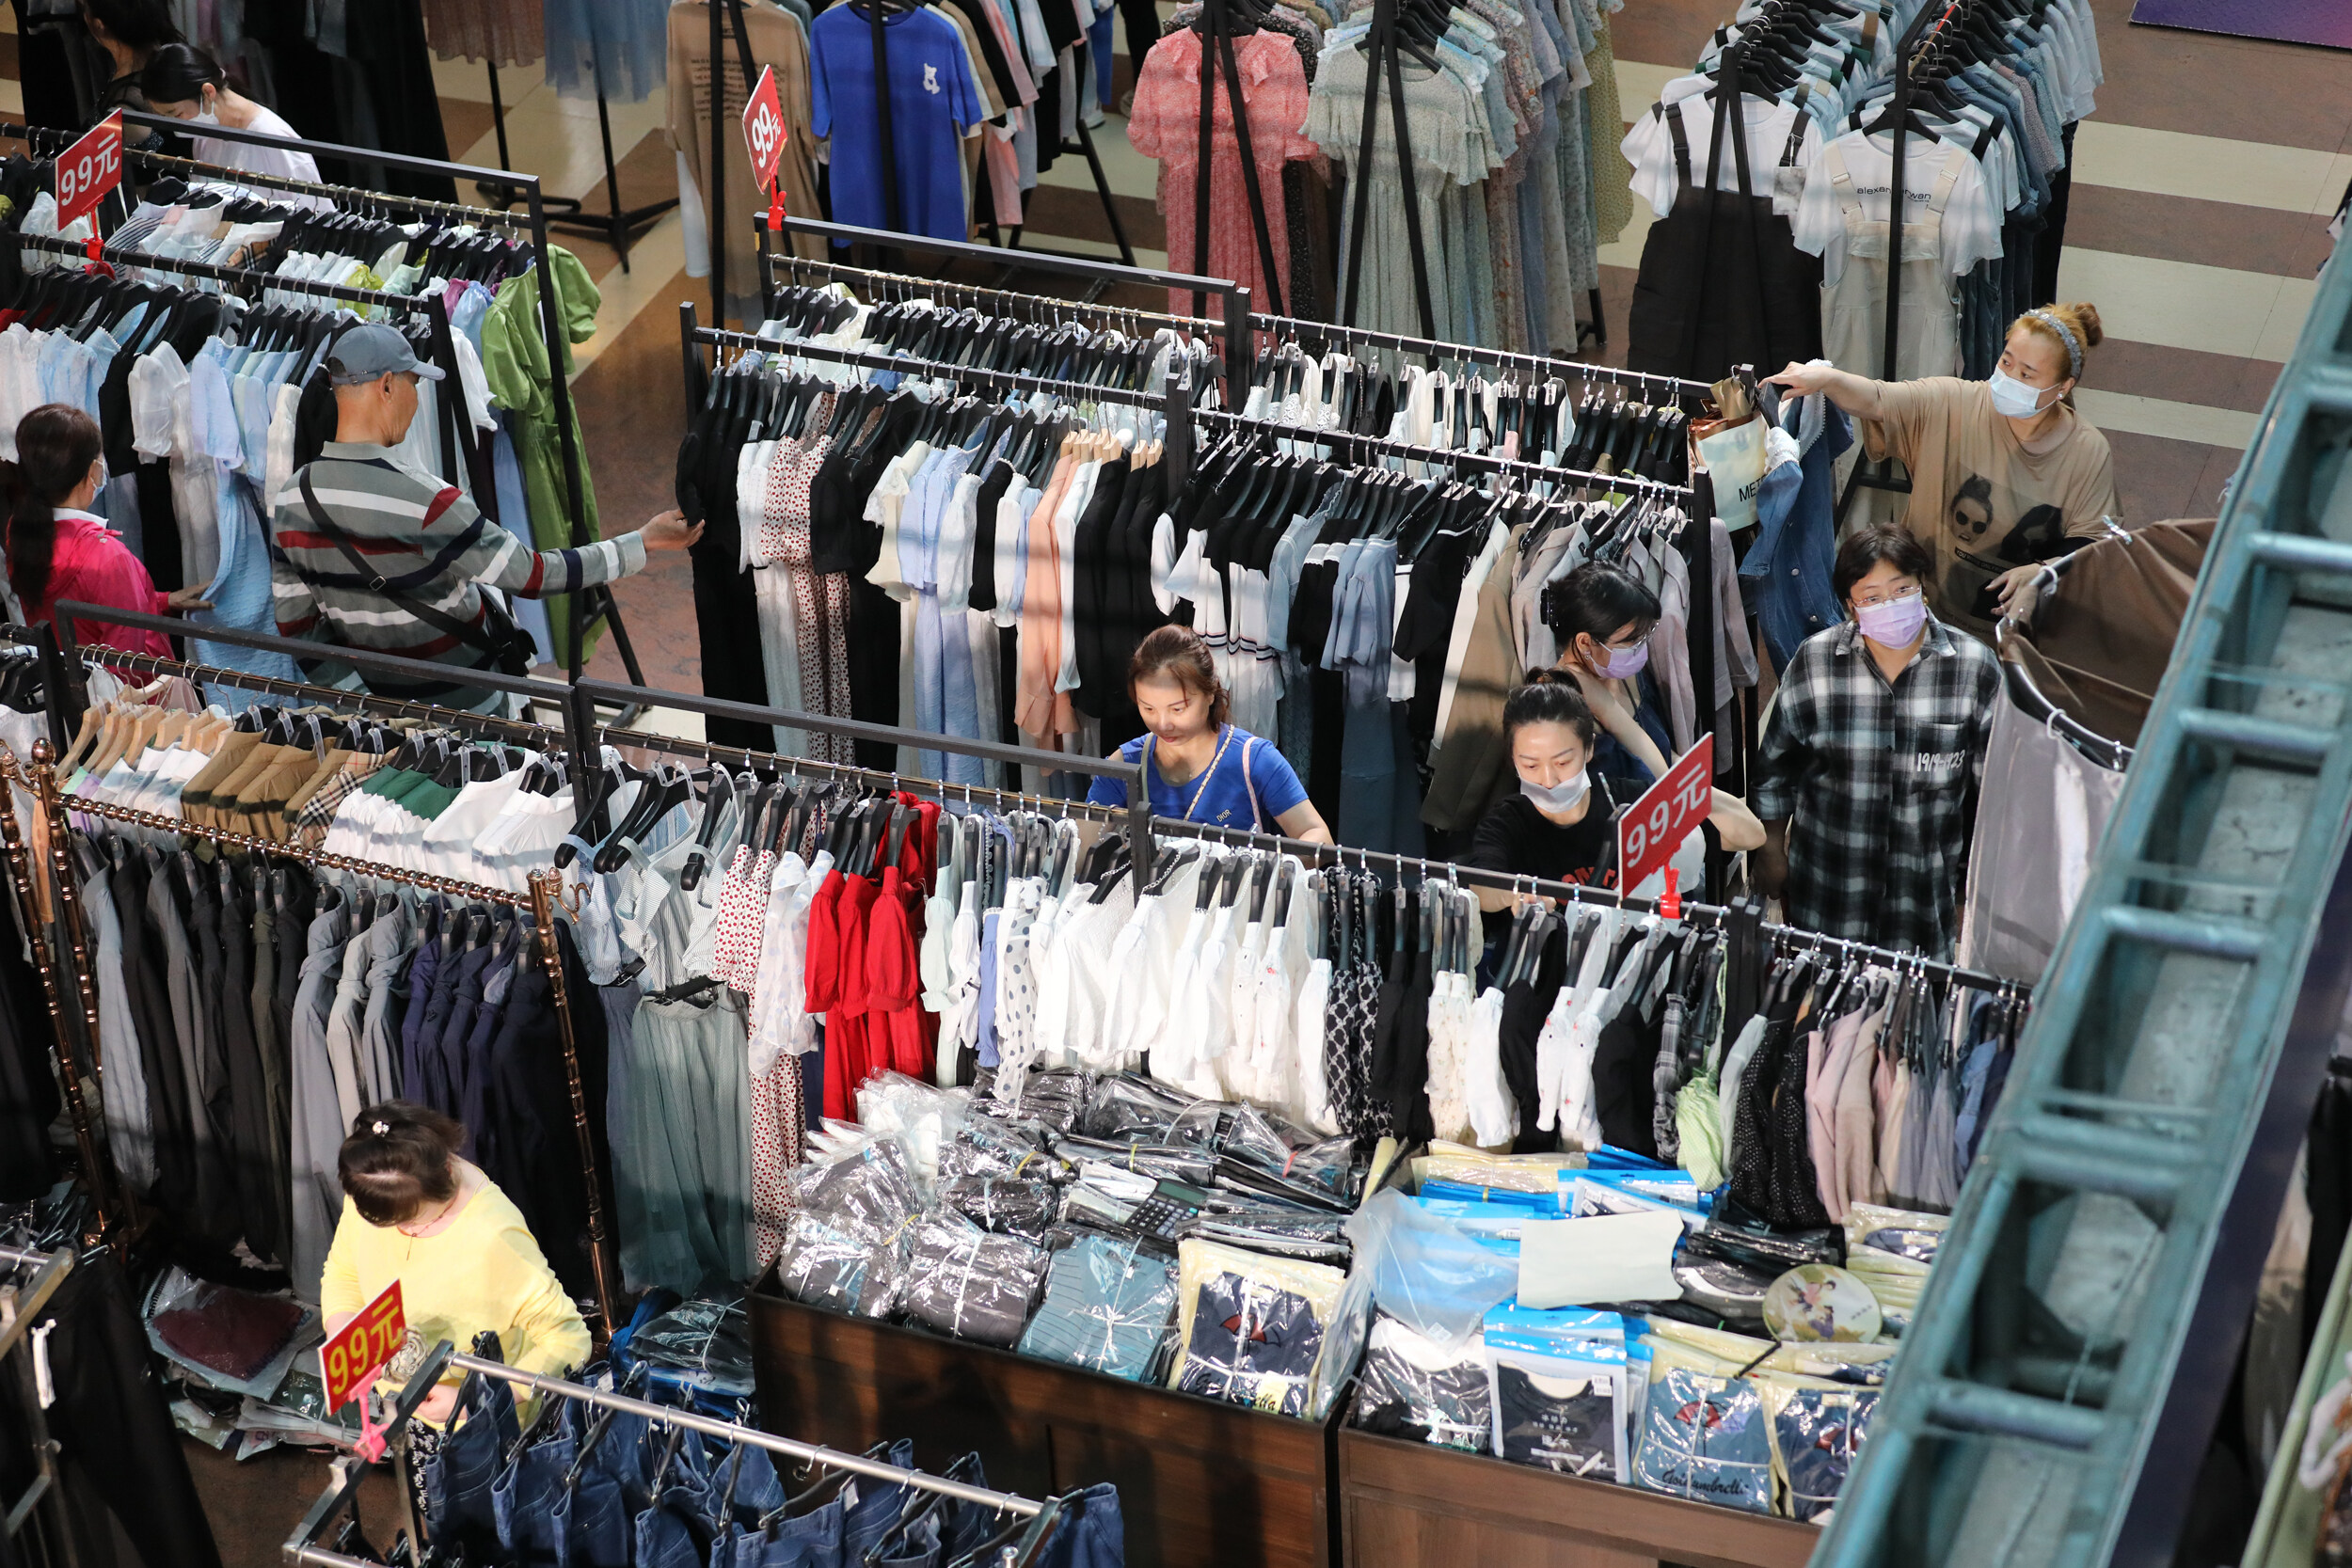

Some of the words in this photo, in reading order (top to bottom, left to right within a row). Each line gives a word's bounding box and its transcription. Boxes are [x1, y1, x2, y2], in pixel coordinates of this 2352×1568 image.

[61, 133, 119, 206] 99元
[752, 103, 781, 168] 99元
[1216, 809, 1232, 822] DIOR
[1626, 762, 1708, 868] 99元
[329, 1294, 403, 1394] 99元
